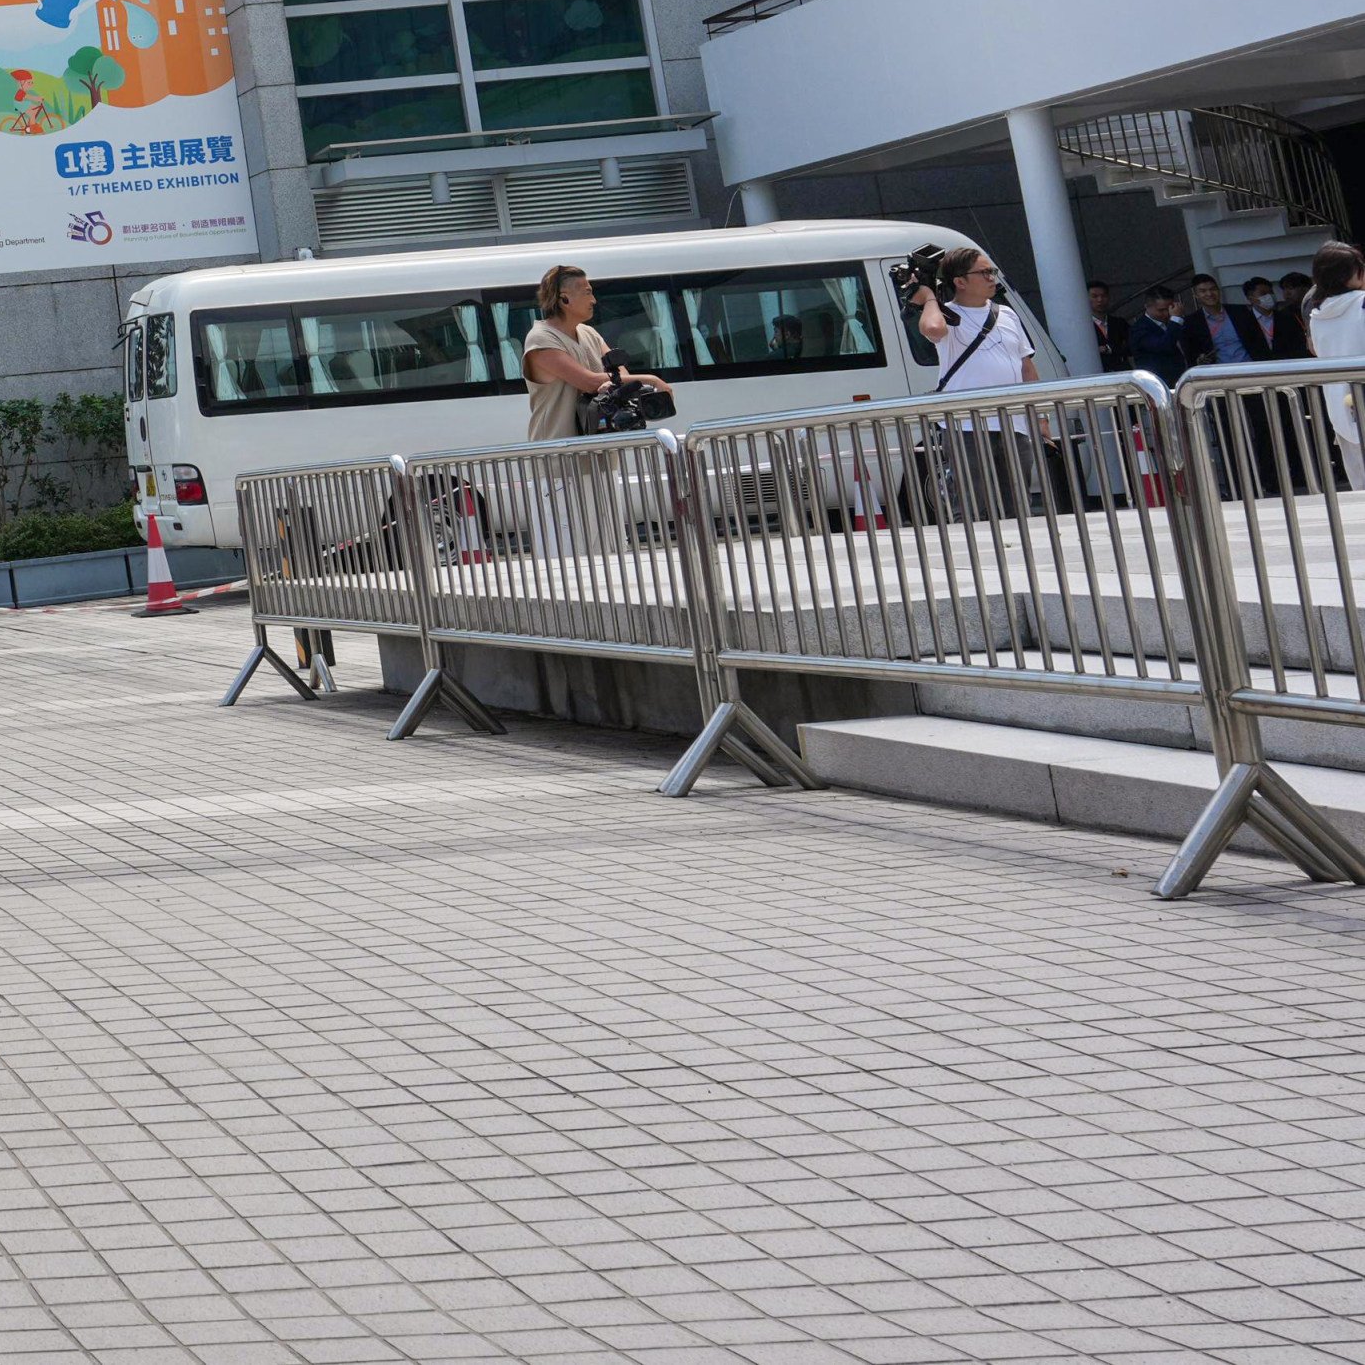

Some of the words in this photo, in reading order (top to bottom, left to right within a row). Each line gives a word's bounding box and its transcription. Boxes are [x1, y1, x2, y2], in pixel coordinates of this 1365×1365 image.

[64, 144, 107, 175] 1樓
[121, 135, 237, 171] 主題展覽
[68, 184, 89, 196] 1/F
[94, 179, 153, 194] THEMED
[157, 172, 239, 190] EXHIBITION
[5, 237, 46, 246] Department
